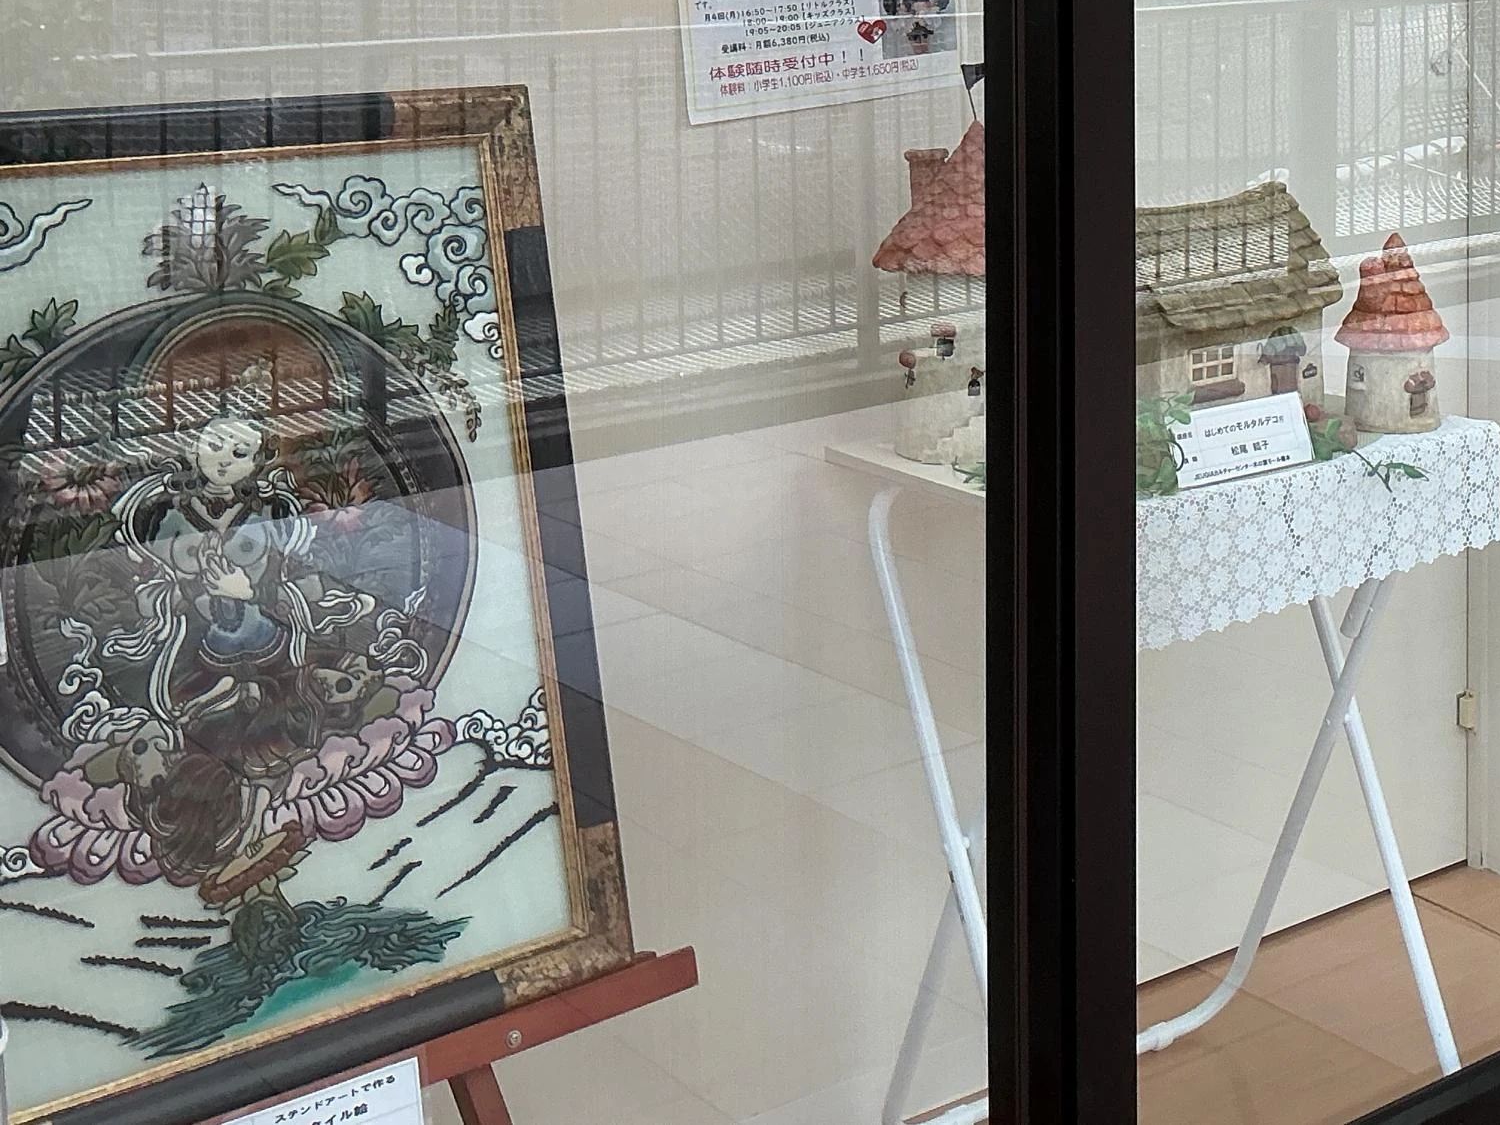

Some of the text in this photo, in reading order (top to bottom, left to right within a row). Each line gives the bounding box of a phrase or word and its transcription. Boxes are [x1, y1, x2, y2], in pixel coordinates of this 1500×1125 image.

[275, 1075, 396, 1124] ステンドアートで作る
